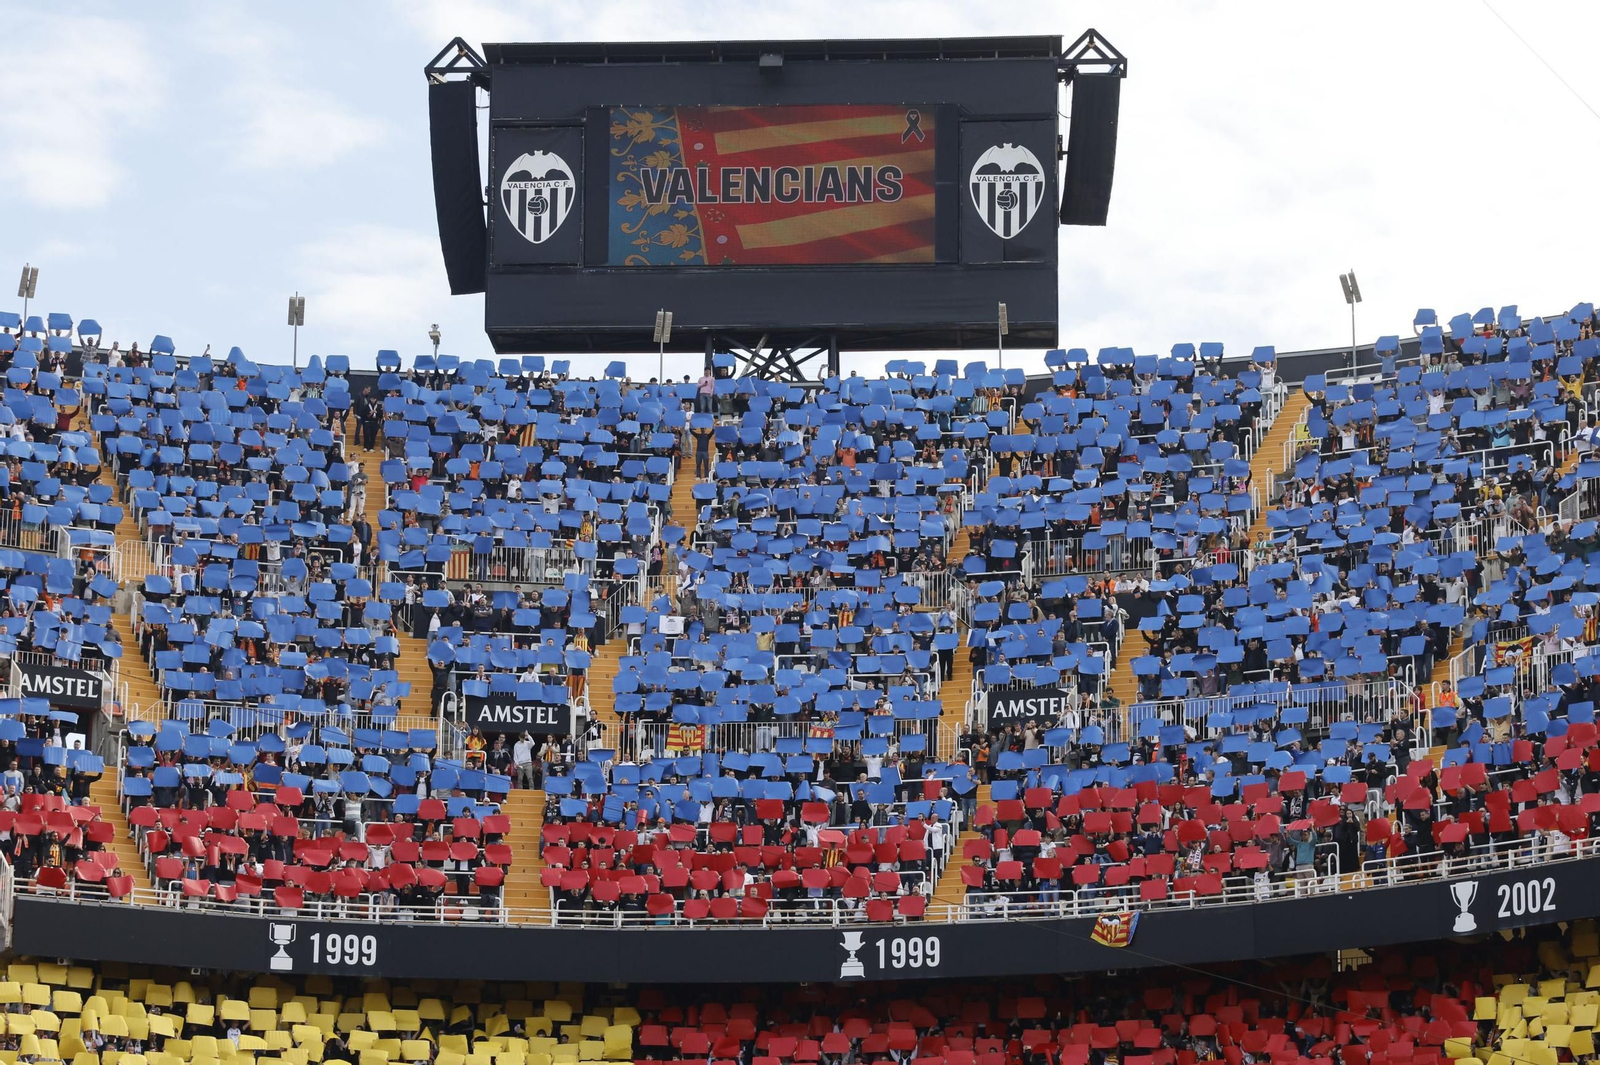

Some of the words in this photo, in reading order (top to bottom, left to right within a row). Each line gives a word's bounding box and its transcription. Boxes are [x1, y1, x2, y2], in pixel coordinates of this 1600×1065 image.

[640, 165, 903, 204] VALENCIANS
[21, 673, 98, 699] AMSTEL
[477, 704, 559, 724] AMSTEL
[1497, 877, 1557, 918] 2002
[310, 932, 377, 966] 1999
[875, 936, 941, 969] 1999
